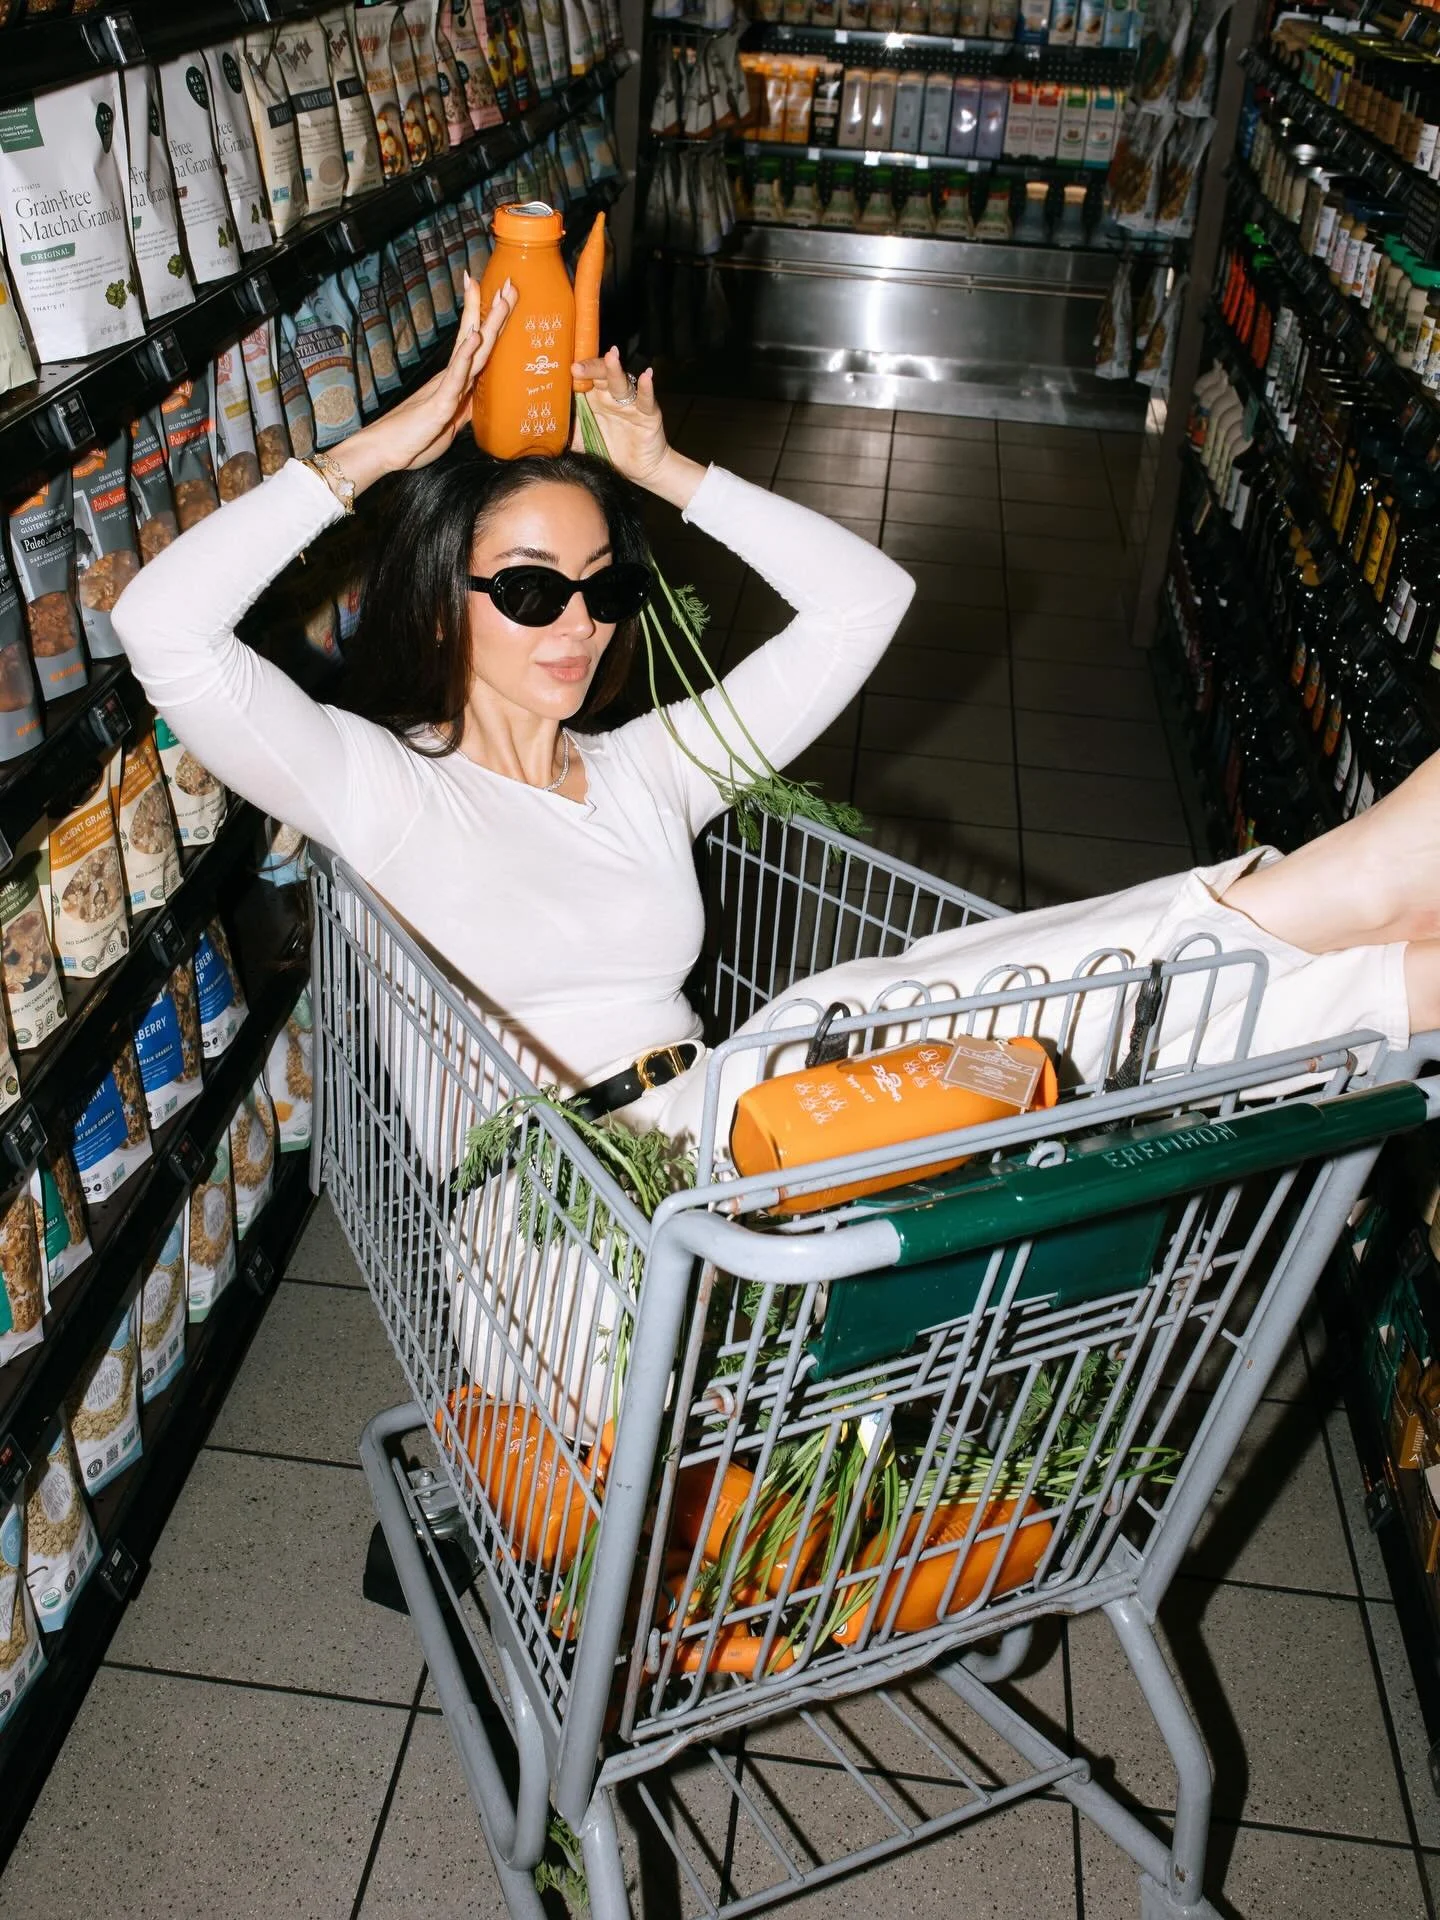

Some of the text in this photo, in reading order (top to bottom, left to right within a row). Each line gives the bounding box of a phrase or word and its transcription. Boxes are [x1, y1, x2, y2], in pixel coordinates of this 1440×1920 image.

[15, 190, 92, 219] Grain-Free
[20, 215, 79, 243] Matcha
[78, 201, 122, 230] Granola
[31, 248, 70, 261] ORIGINAL
[33, 303, 57, 313] THAT'S
[296, 344, 317, 359] STEEL
[99, 468, 123, 482] GRAIN FREE
[90, 484, 107, 494] GLUTEN
[107, 479, 117, 488] FREE
[19, 510, 47, 526] ORGANIC
[20, 522, 44, 534] GLUTEN
[23, 536, 45, 552] Paleo
[60, 821, 84, 848] ANCIENT
[85, 806, 112, 828] GRAINS
[108, 942, 117, 953] GF
